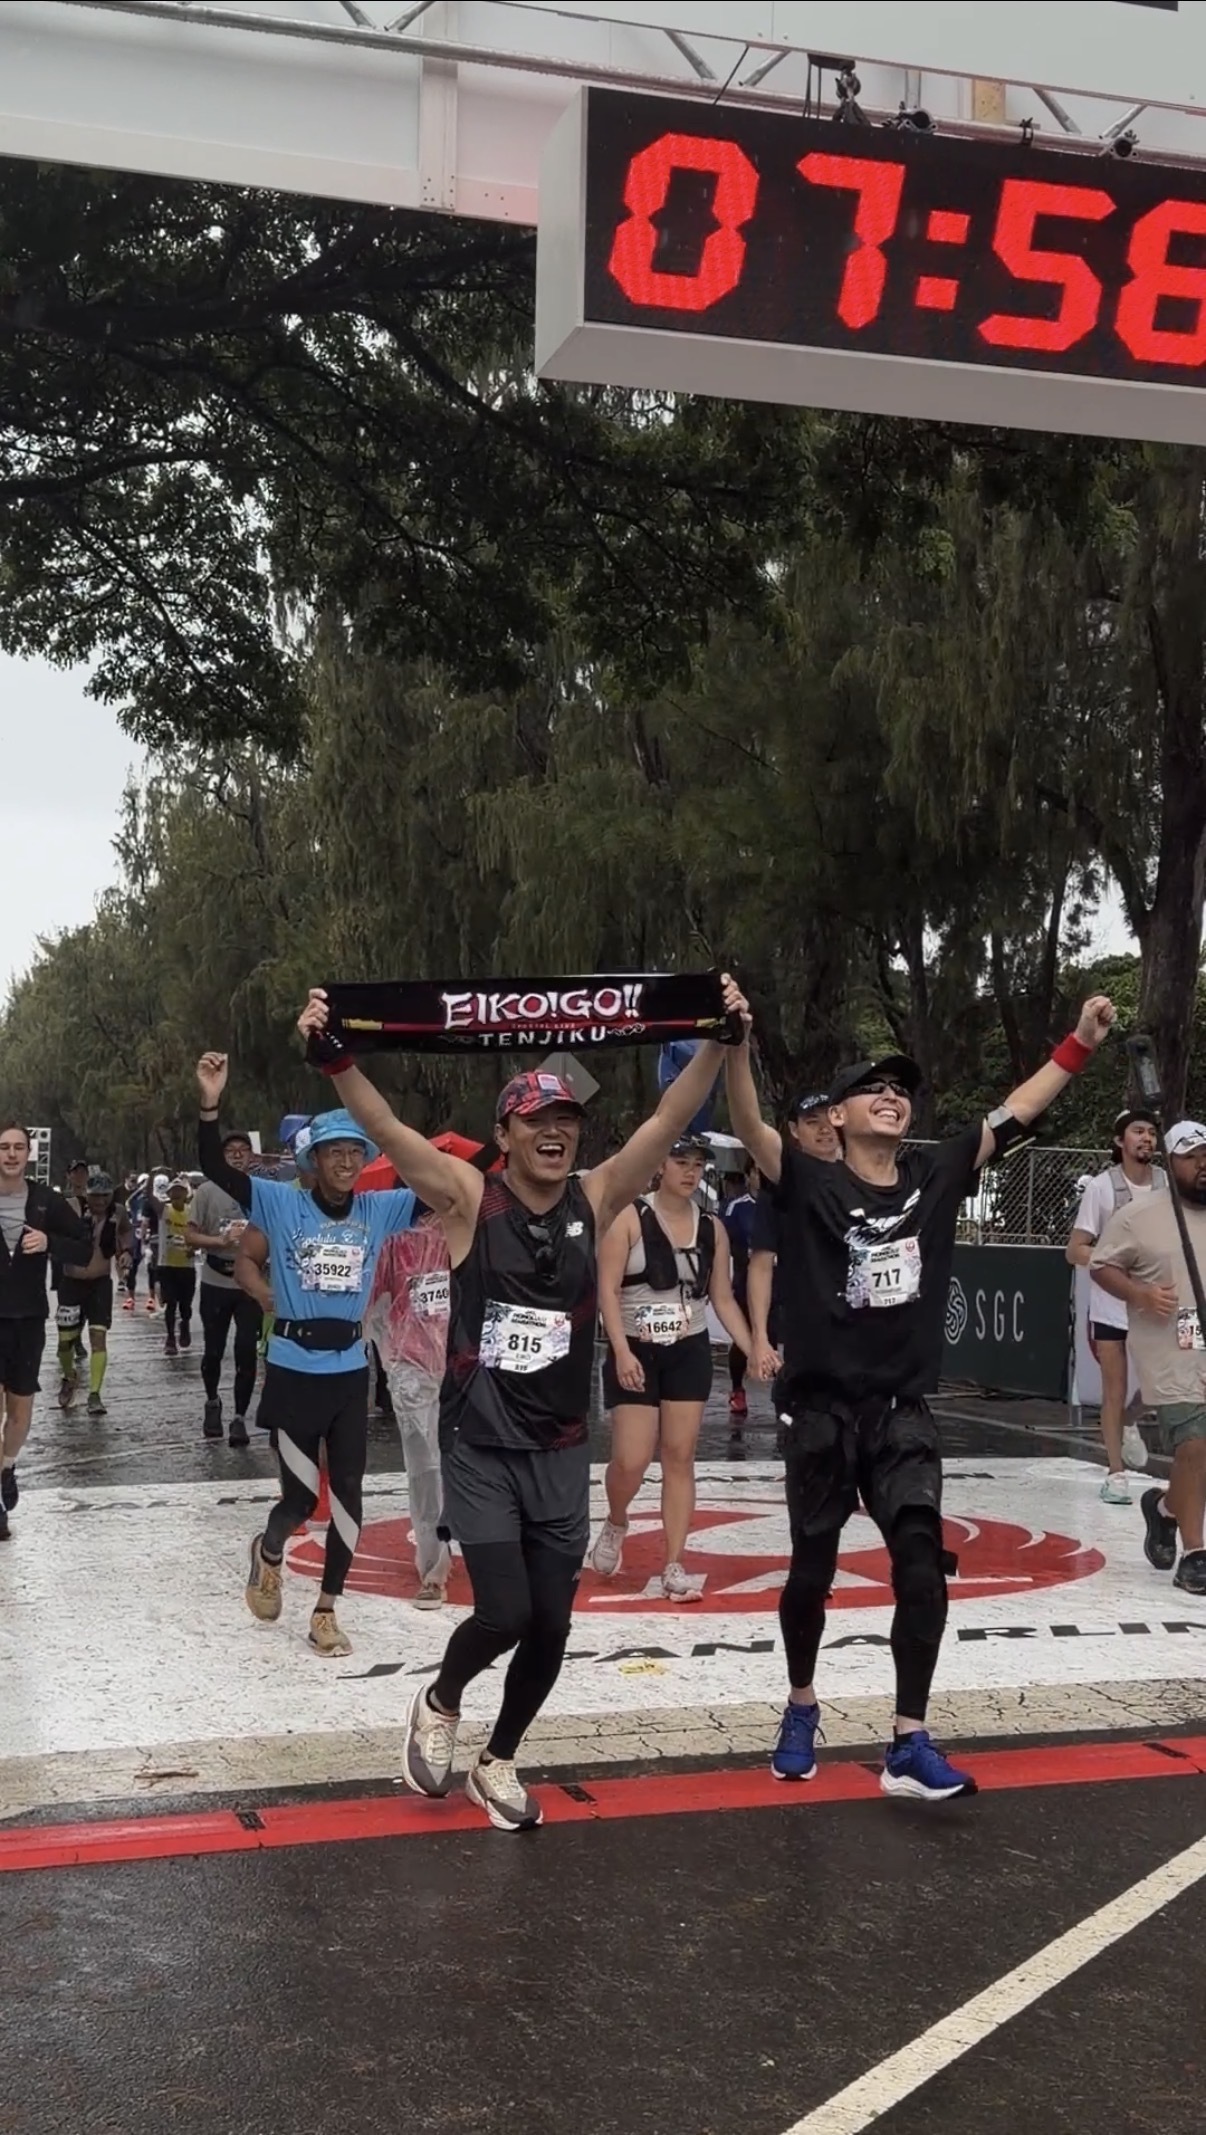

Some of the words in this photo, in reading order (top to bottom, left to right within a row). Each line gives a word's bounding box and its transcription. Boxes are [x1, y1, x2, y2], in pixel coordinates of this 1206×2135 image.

[479, 1026, 606, 1046] TENJIKU
[314, 1263, 352, 1278] 35922
[871, 1268, 901, 1288] 717
[975, 1289, 1025, 1342] SGC
[508, 1333, 543, 1354] 815
[335, 1639, 776, 1680] JAN
